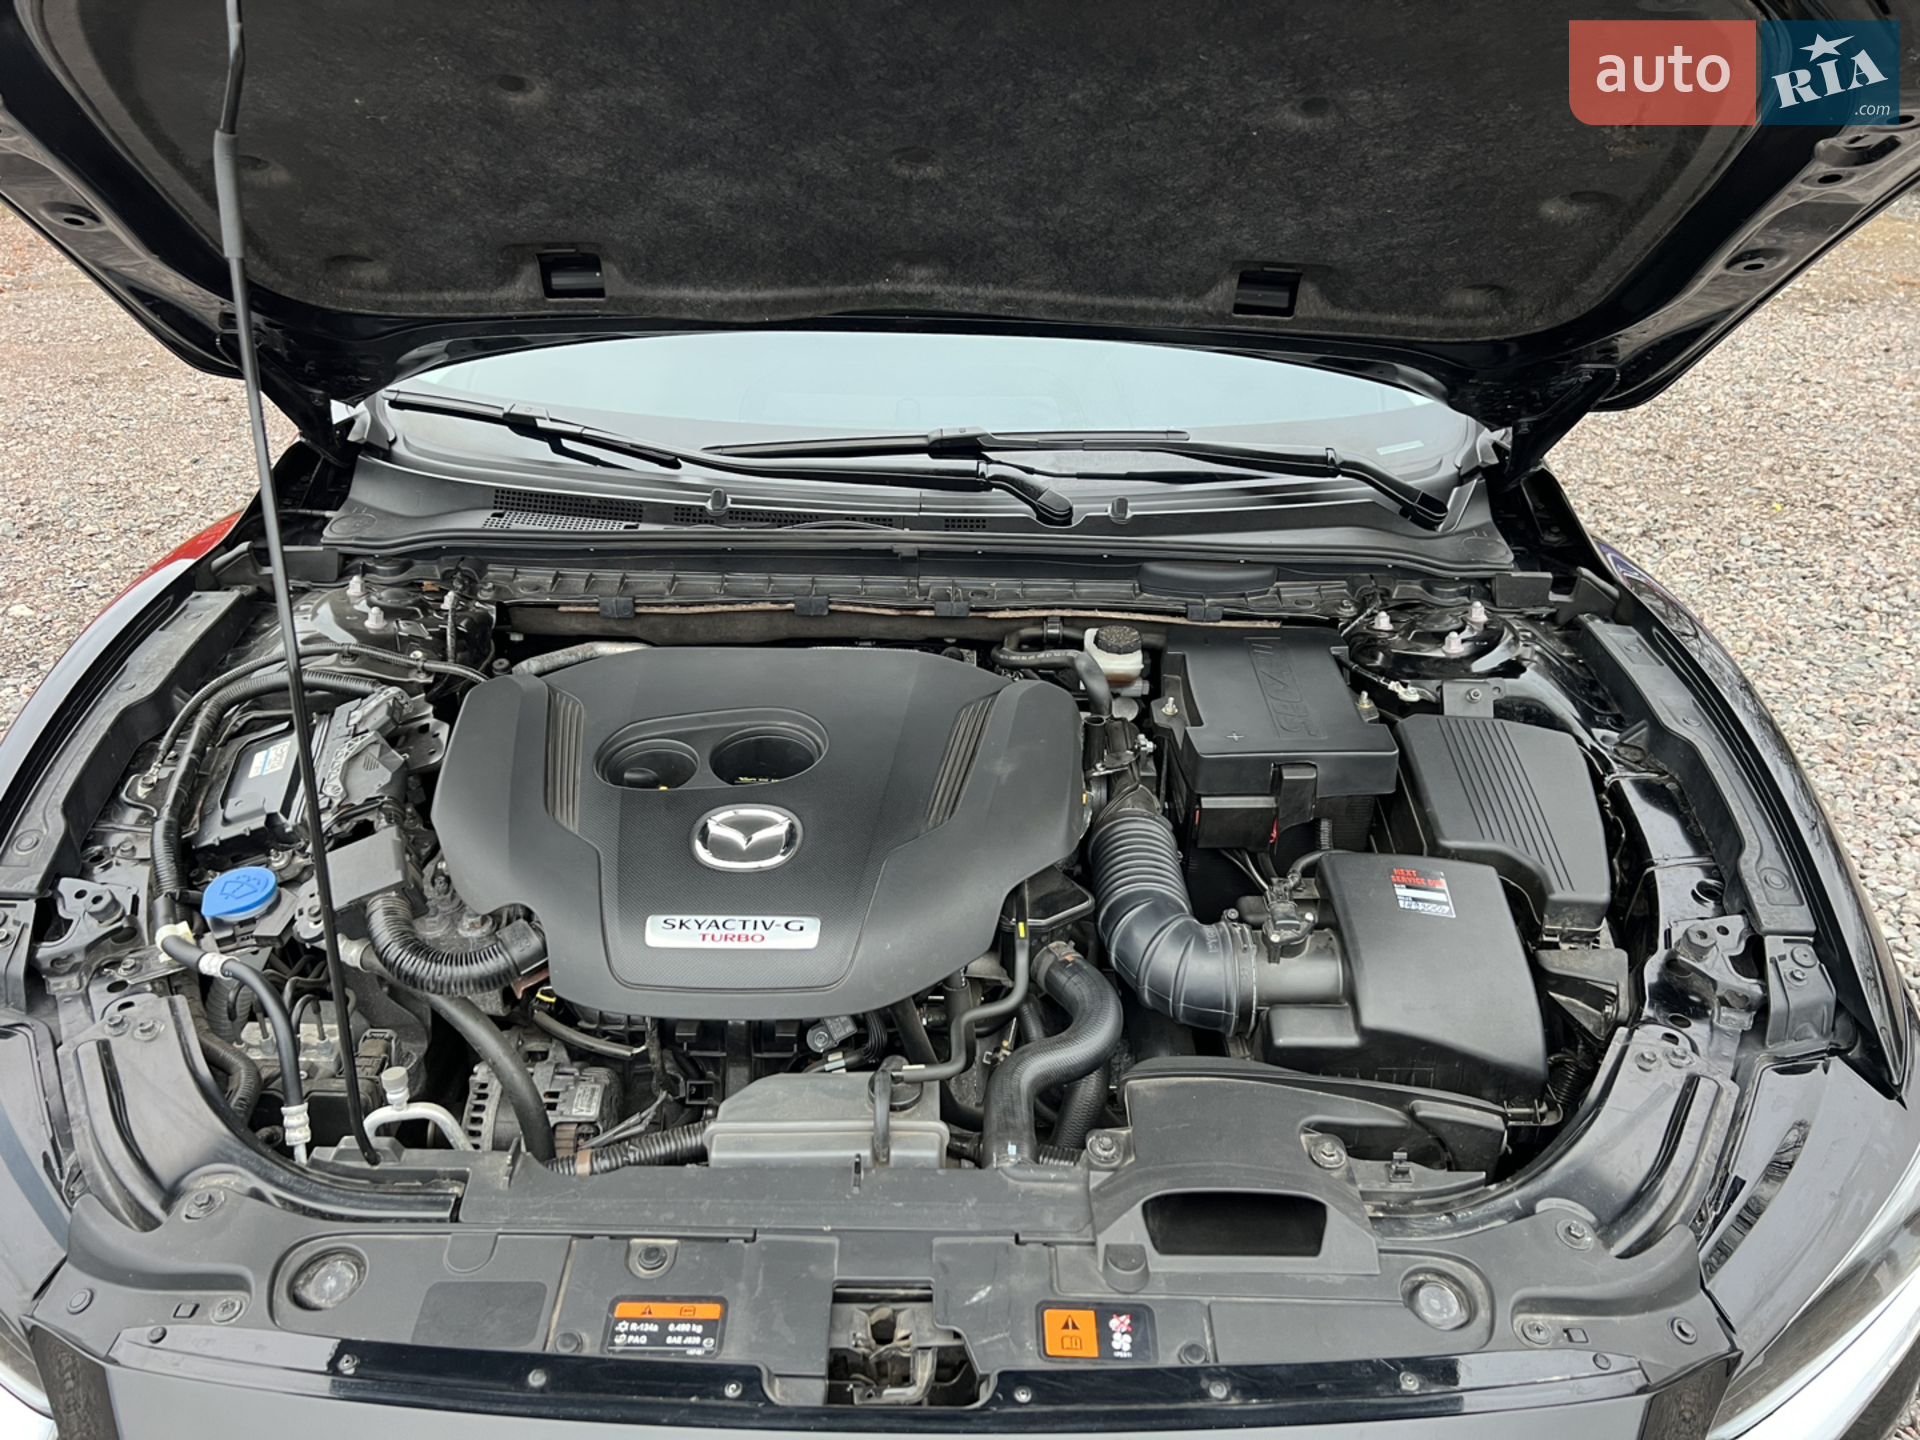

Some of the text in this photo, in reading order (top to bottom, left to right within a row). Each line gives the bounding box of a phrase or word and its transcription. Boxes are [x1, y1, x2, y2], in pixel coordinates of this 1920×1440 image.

[1393, 868, 1417, 877] NEXT
[1391, 875, 1425, 886] SERVICE
[661, 918, 806, 932] SKYACTIV-G
[698, 932, 766, 943] TURBO
[629, 1322, 659, 1333] R-134a
